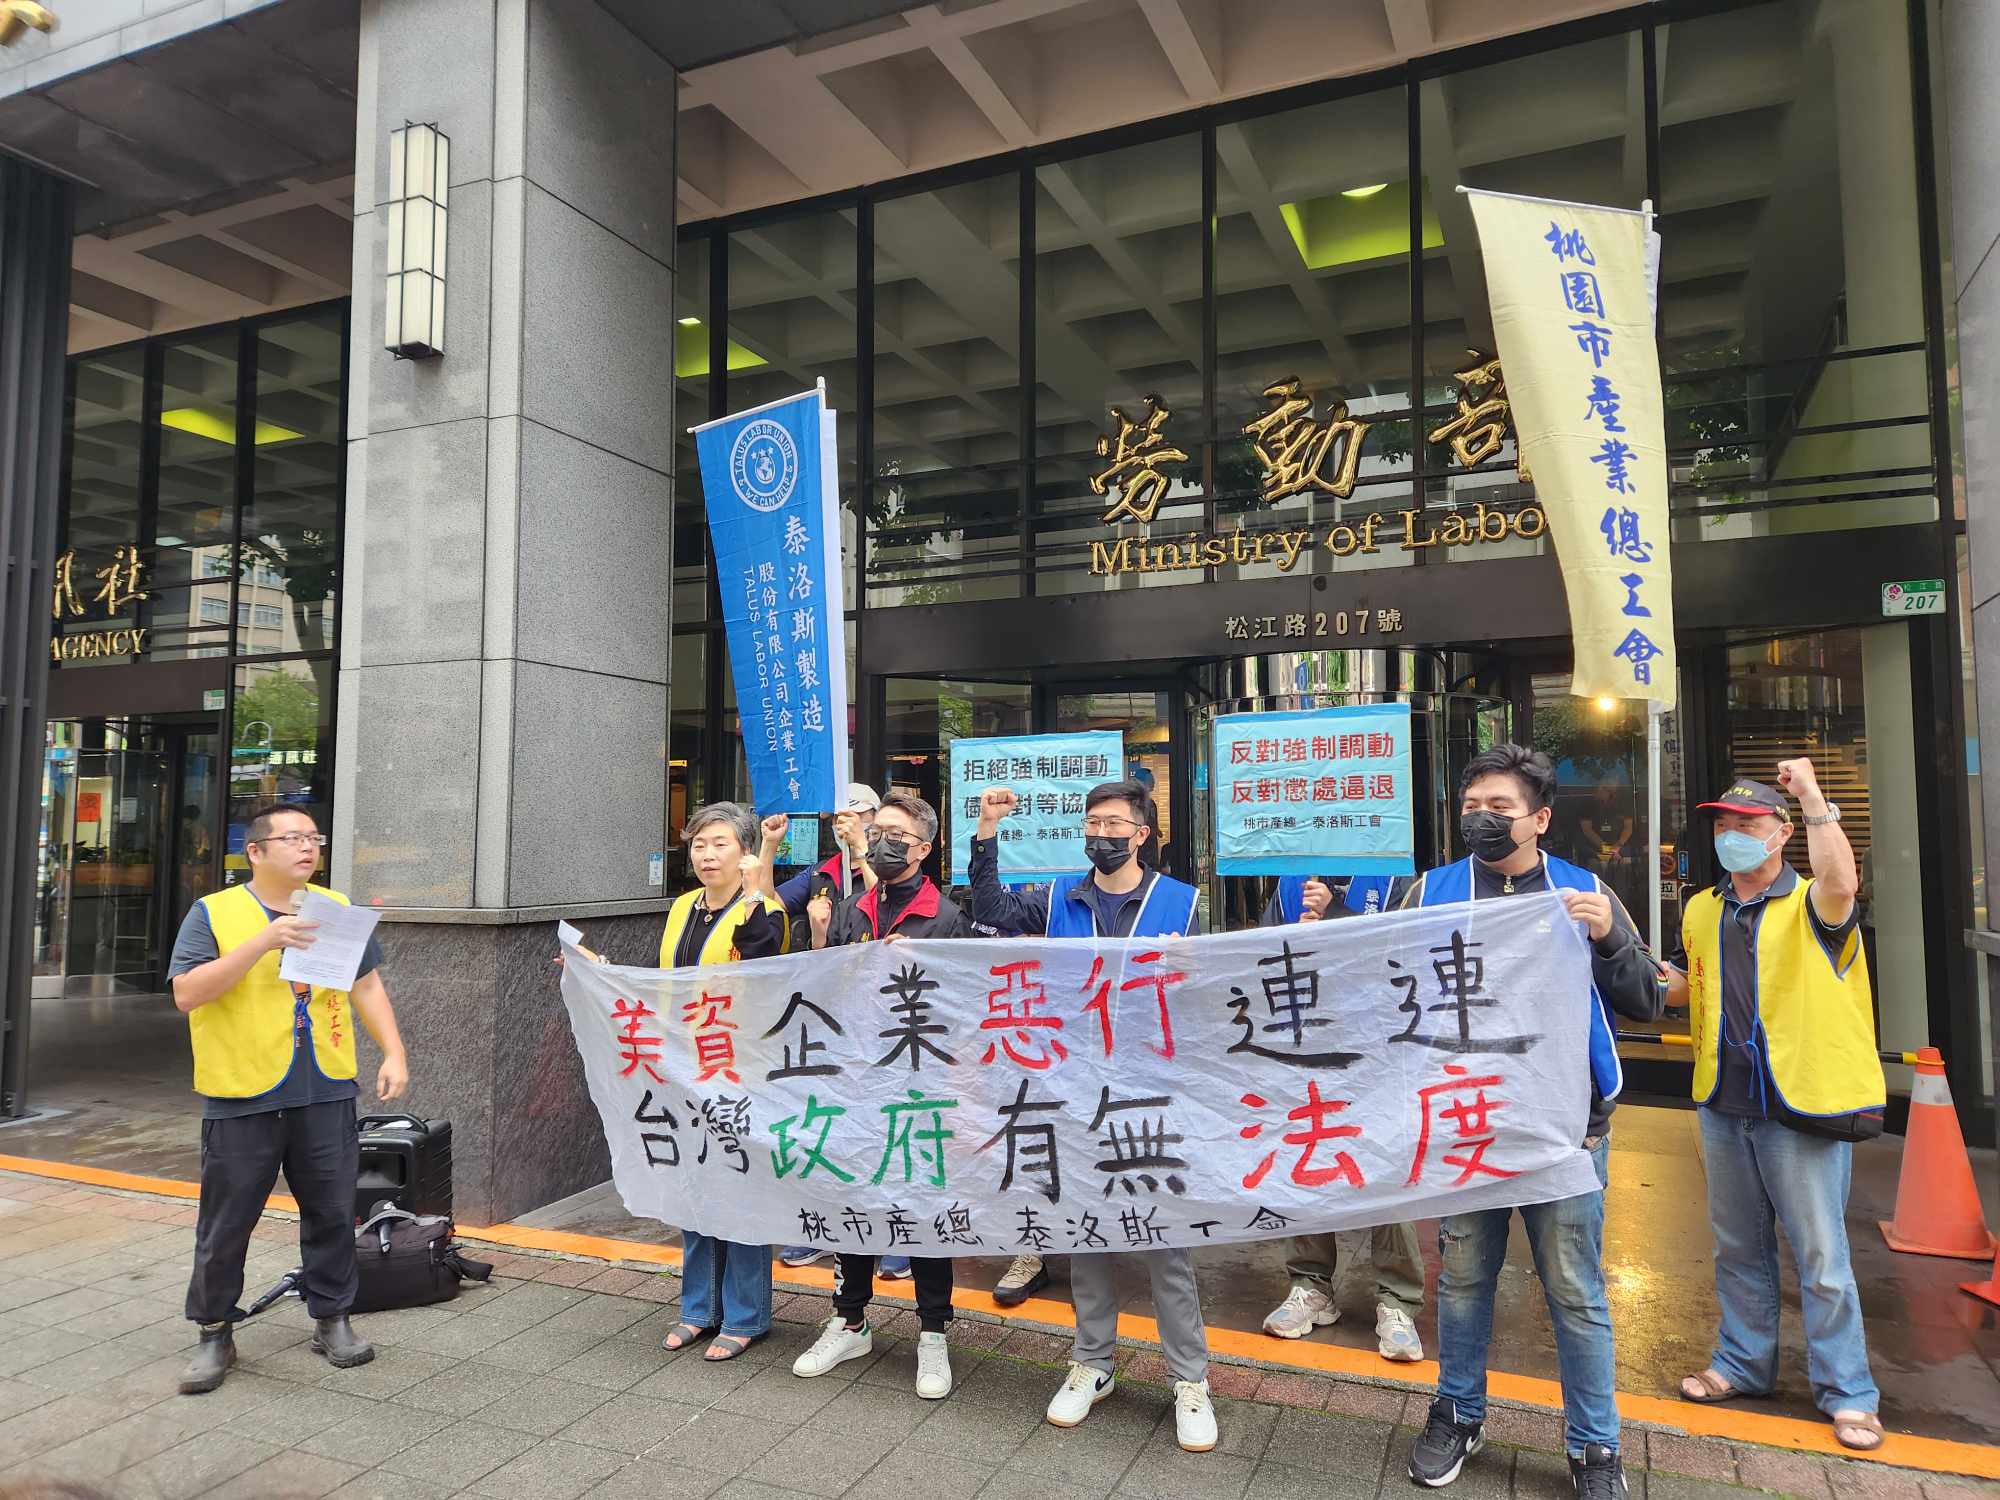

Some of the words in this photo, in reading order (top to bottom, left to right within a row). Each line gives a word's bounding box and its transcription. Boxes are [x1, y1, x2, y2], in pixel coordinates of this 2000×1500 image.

[745, 424, 773, 441] LABOR
[774, 428, 793, 458] UNION
[1543, 220, 1665, 687] 桃園市產業總工會
[745, 487, 759, 504] WE
[760, 496, 775, 507] CAN
[1087, 525, 1308, 576] Ministry
[1323, 511, 1385, 556] of
[1398, 502, 1549, 550] Labo
[1904, 594, 1938, 610] 207
[783, 514, 825, 732] 泰洛斯製造
[1225, 608, 1402, 639] 松江路207號
[51, 628, 148, 660] AGENCY
[743, 565, 761, 623] TALUS
[752, 630, 769, 689] LABOR
[761, 697, 779, 752] UNION
[758, 560, 801, 801] 股份有限公司企業工會
[1230, 732, 1395, 765] 反對強制調動
[963, 754, 1109, 782] 拒絕強制調動
[1231, 774, 1395, 804] 反對懲處逼退
[610, 929, 1546, 1084] 美資企業惡行連連
[633, 1064, 1524, 1205] 台灣政府有無法度
